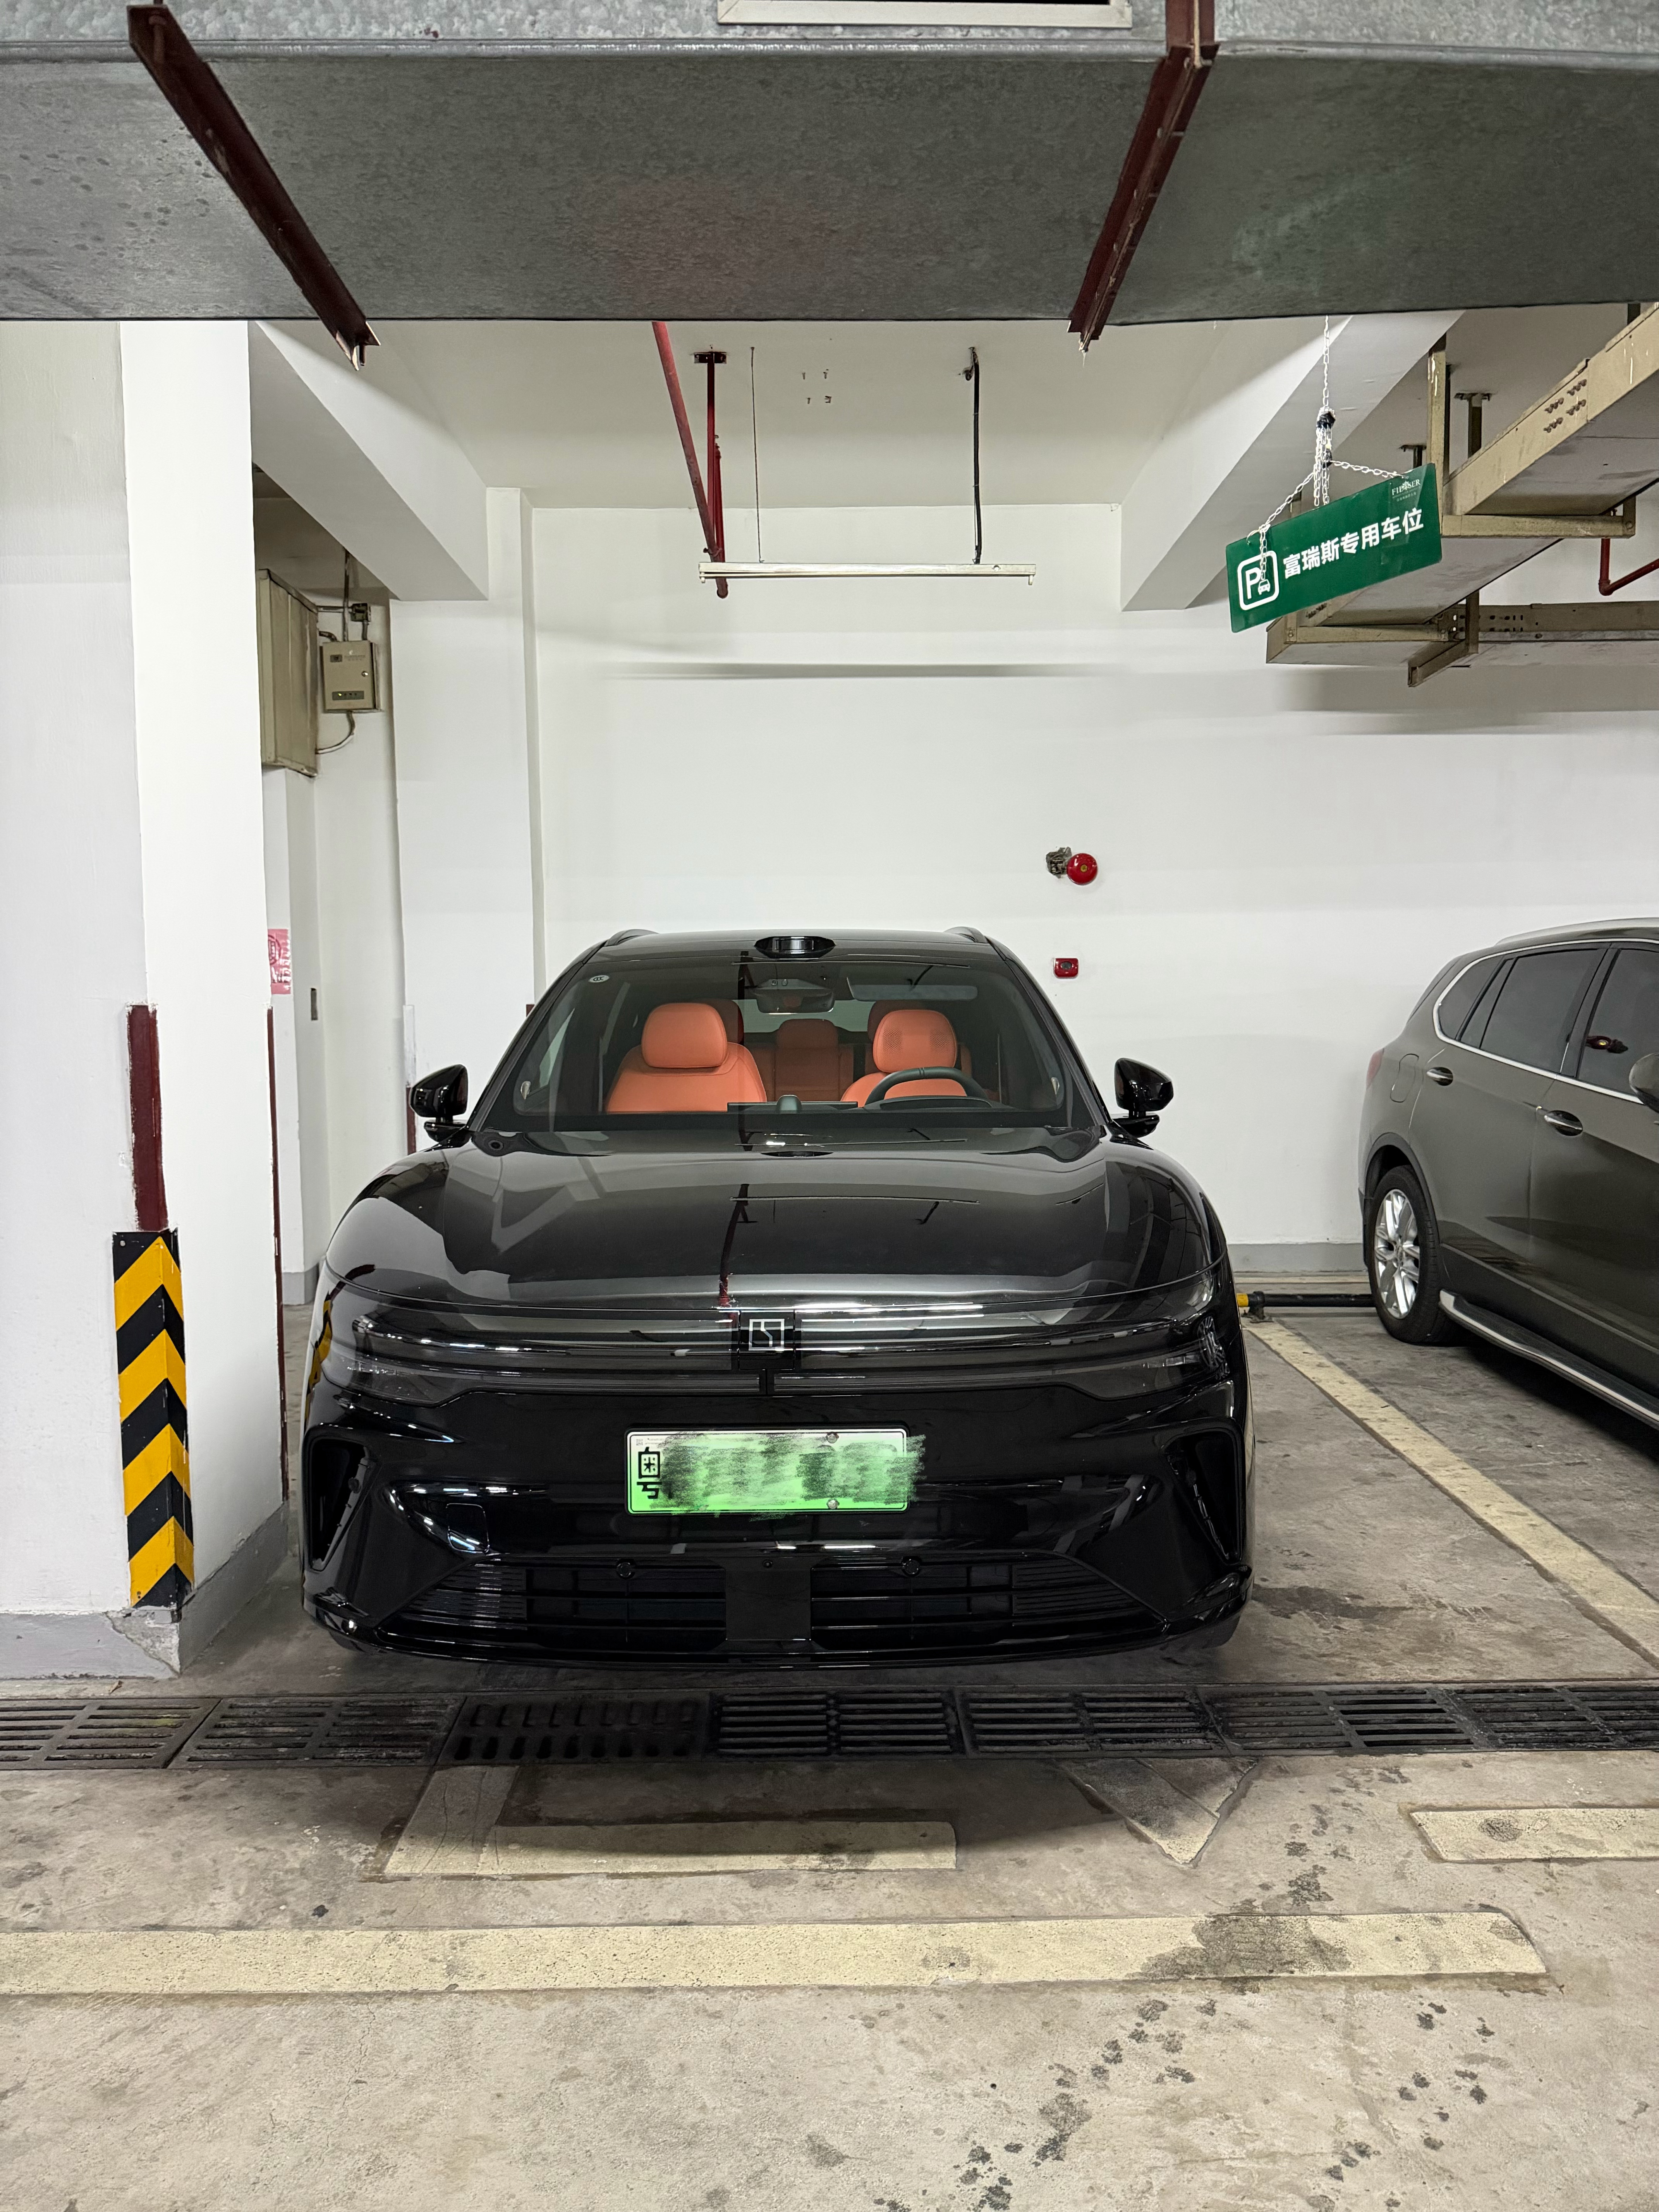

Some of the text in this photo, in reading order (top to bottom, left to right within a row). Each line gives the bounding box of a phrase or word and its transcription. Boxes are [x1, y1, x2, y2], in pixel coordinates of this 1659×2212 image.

[1283, 507, 1424, 579] 富瑞斯专用车位
[1245, 567, 1262, 599] P
